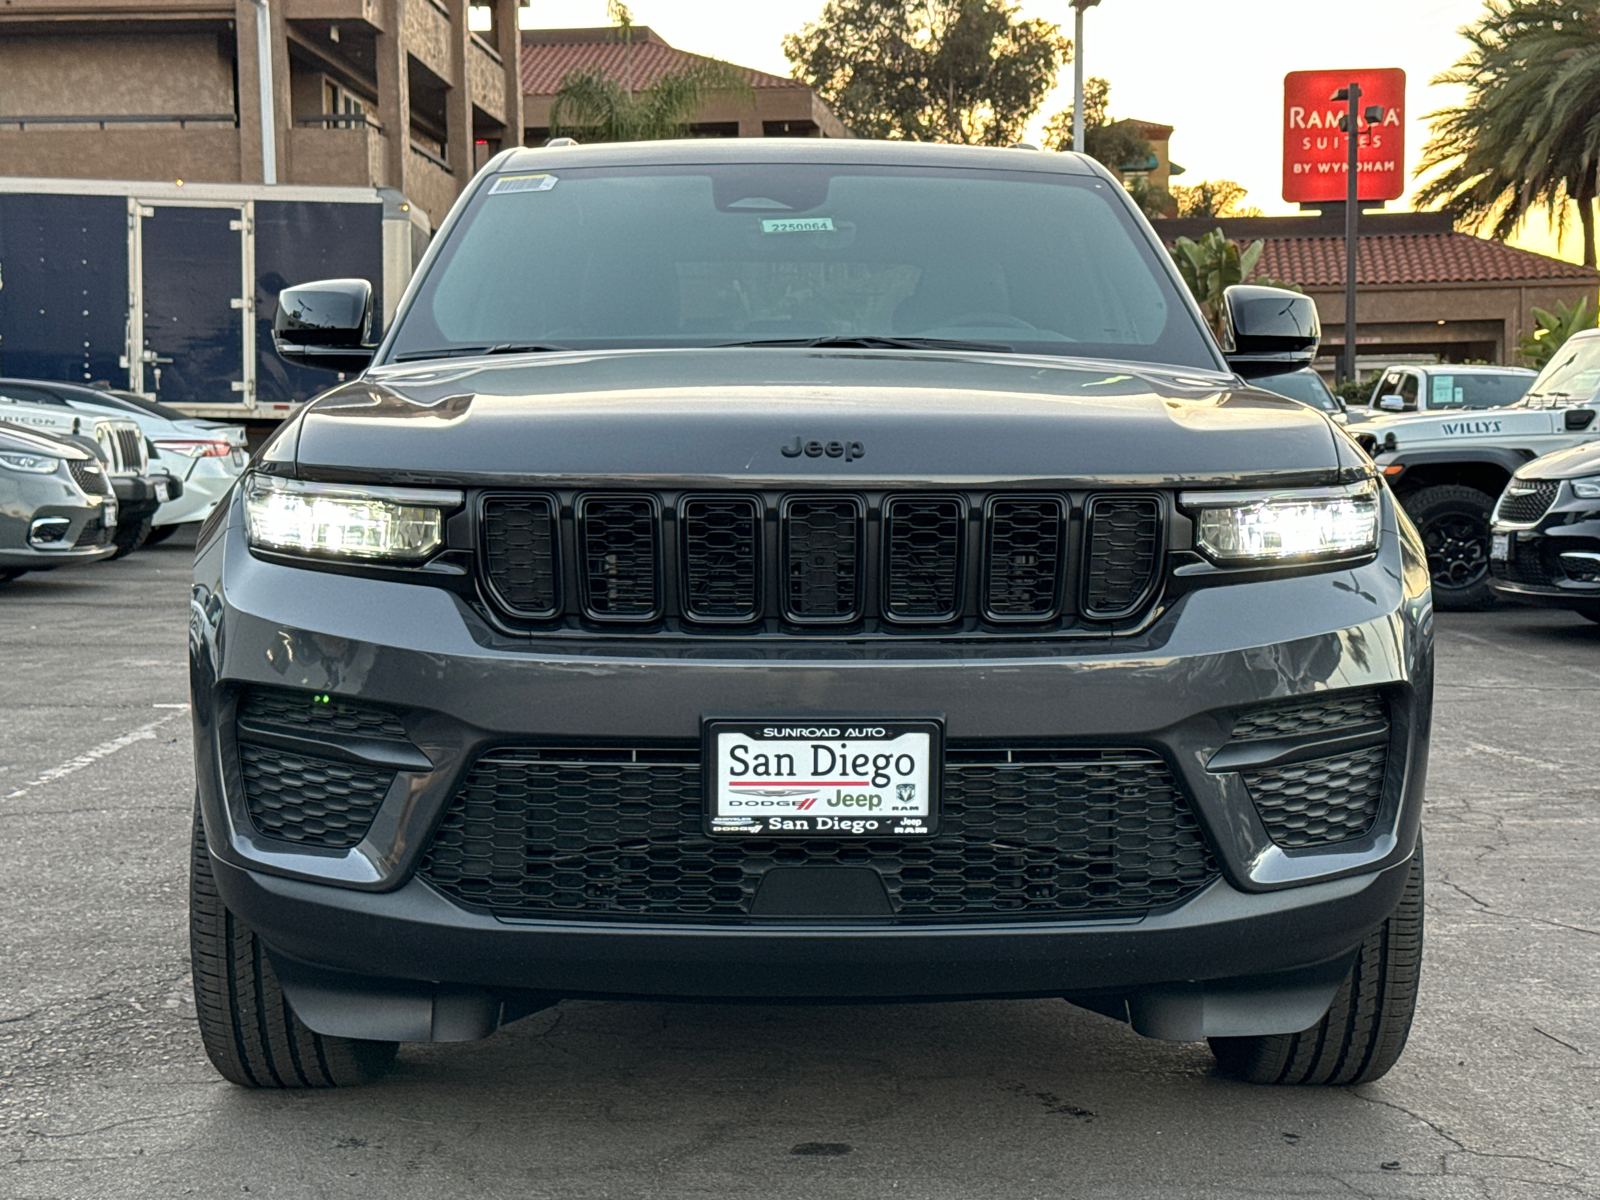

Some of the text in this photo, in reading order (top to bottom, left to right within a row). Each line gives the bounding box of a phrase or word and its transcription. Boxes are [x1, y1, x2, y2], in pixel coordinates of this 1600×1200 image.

[1289, 106, 1399, 129] RAMA
[1293, 163, 1312, 174] BY
[771, 222, 829, 232] 2250064
[1442, 421, 1502, 435] WILLYS
[781, 436, 865, 462] Jeep
[763, 727, 886, 737] SUNROAD AUTO
[729, 743, 915, 788] San Diego
[827, 789, 882, 811] Jeep
[768, 817, 879, 833] San Diego
[900, 817, 922, 827] Jeep
